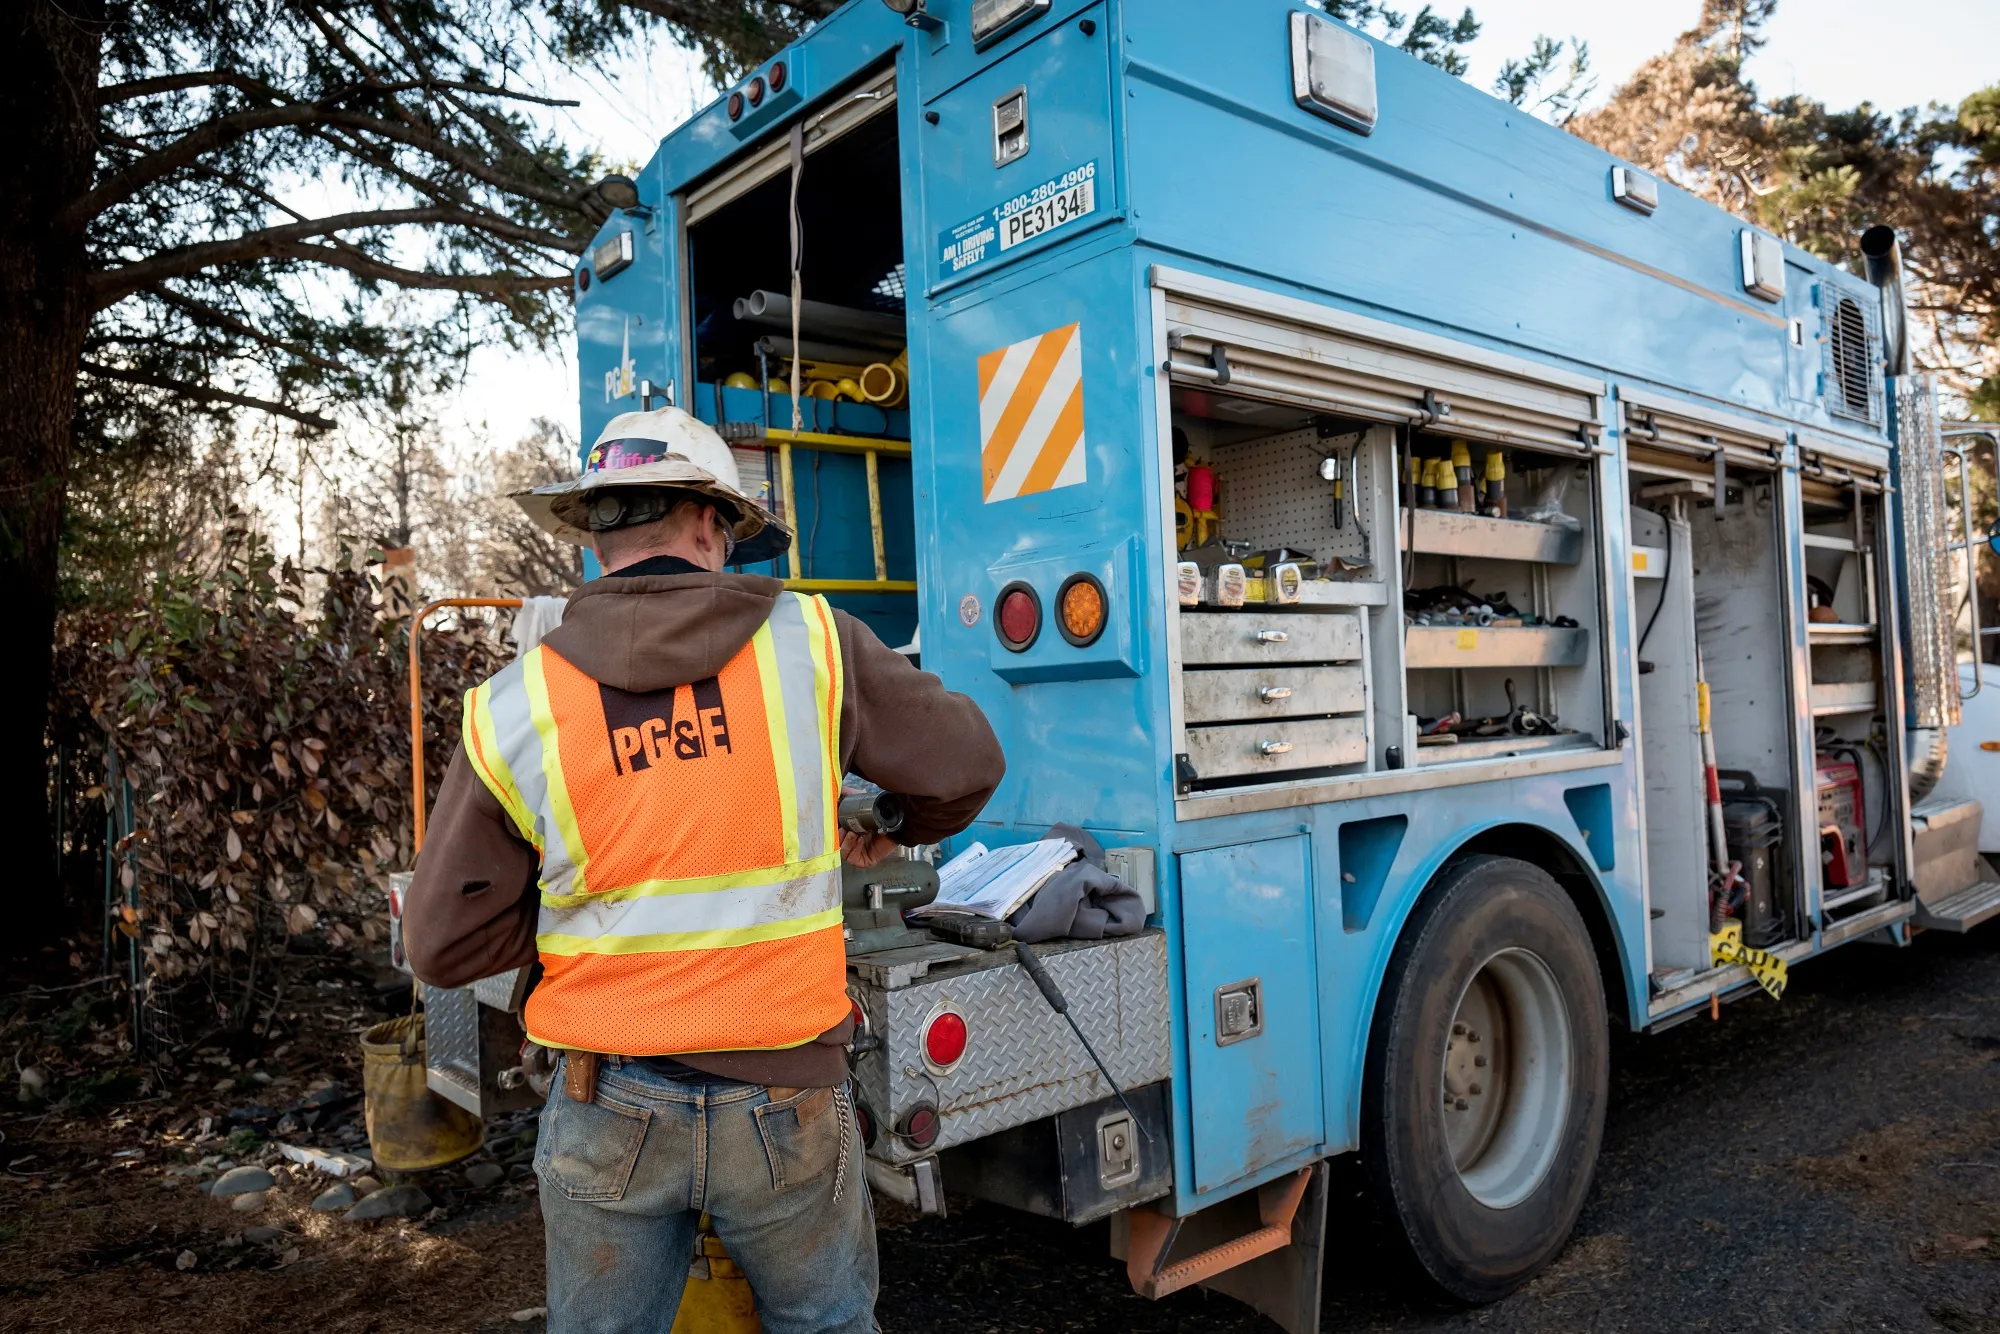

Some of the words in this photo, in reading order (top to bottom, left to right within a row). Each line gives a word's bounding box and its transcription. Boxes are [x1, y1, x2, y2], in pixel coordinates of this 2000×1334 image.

[992, 162, 1095, 221] 1-800-280-4906
[1009, 188, 1080, 245] PE3134
[943, 244, 957, 262] AM
[957, 241, 962, 256] I
[962, 226, 995, 254] DRIVING
[953, 245, 985, 271] SAFELY?
[605, 358, 636, 404] PG&E
[612, 706, 730, 776] PG&E
